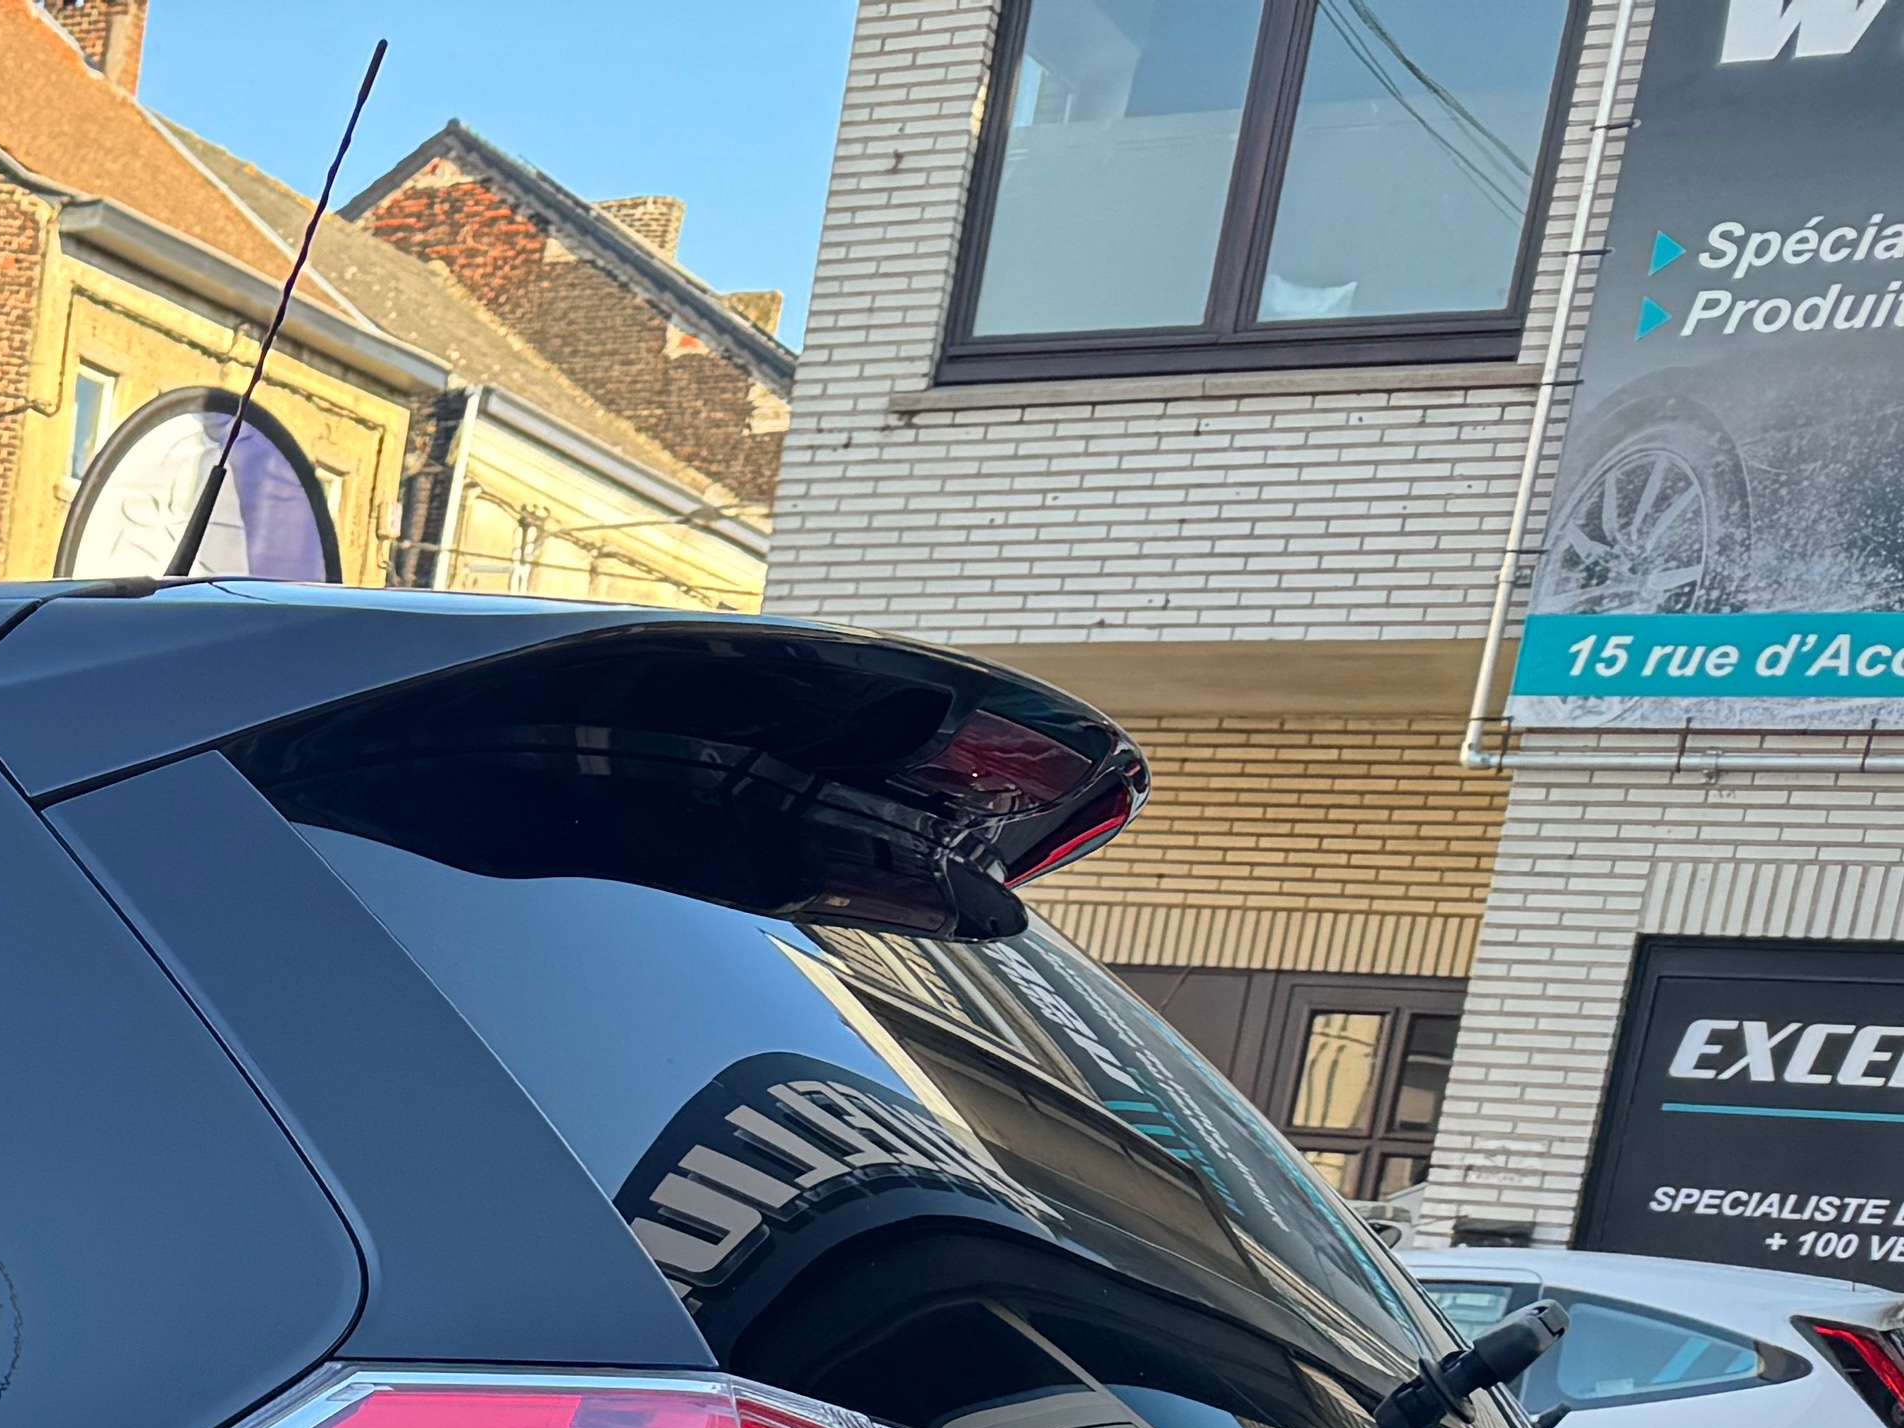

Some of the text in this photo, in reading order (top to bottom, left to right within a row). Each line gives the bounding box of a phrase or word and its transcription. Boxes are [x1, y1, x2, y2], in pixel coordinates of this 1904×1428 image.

[1568, 634, 1634, 677] 15
[1640, 643, 1740, 677] rue
[1648, 1186, 1890, 1225] SPECIALISTE
[1797, 1230, 1859, 1259] 100
